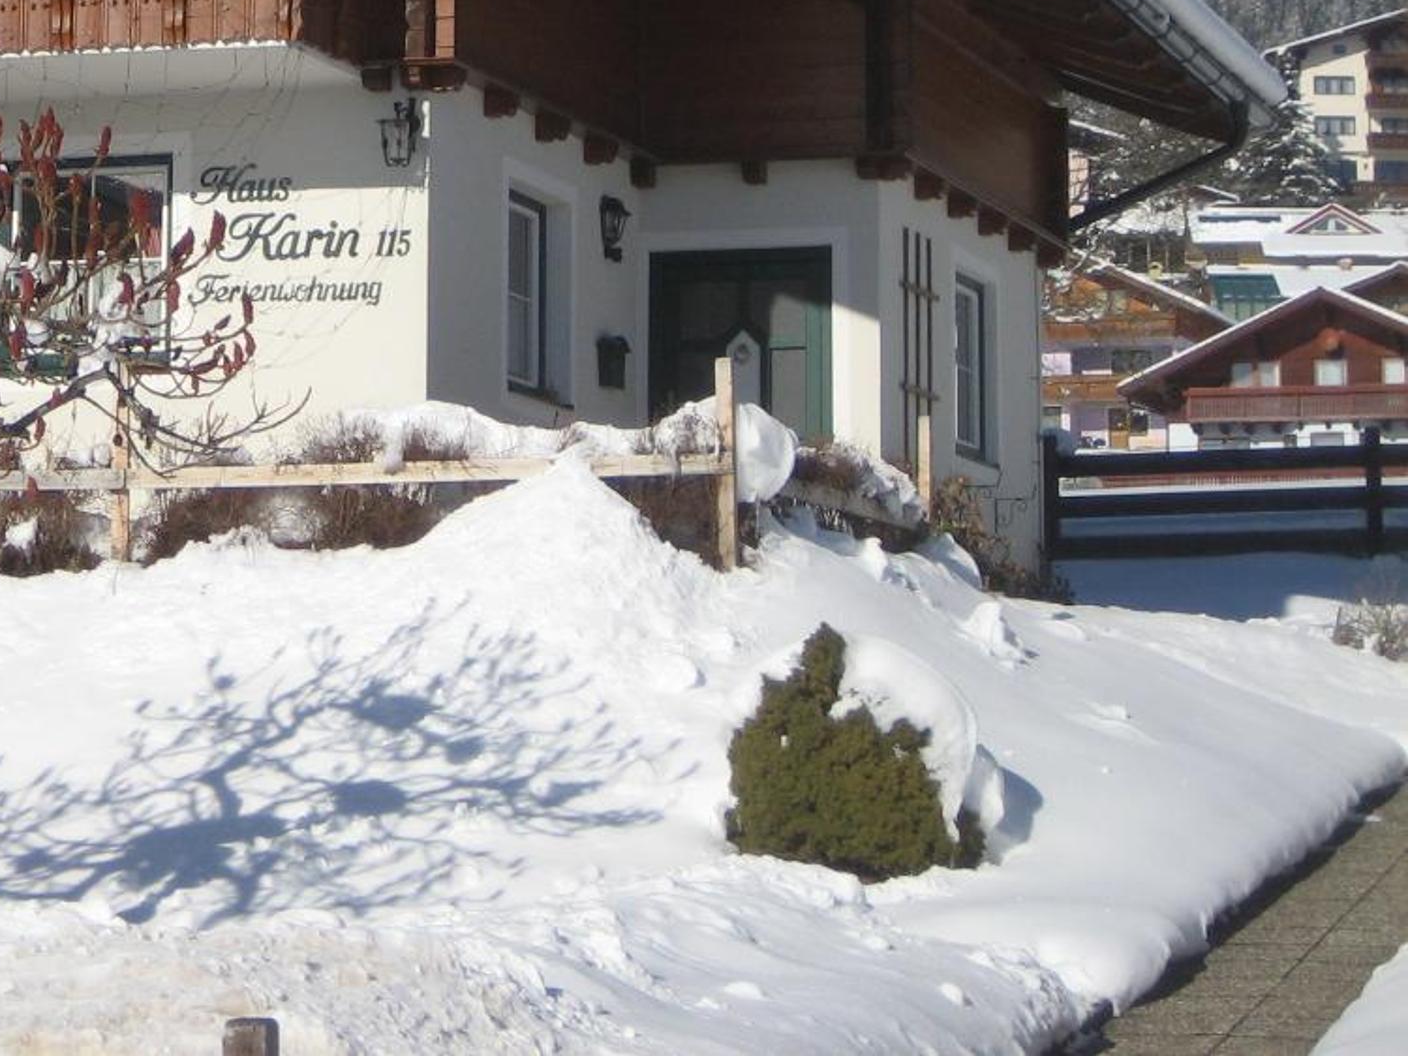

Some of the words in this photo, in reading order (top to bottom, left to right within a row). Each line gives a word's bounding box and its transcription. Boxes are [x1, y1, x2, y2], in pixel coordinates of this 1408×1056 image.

[190, 163, 292, 205] Haus
[216, 212, 359, 262] Karin
[375, 228, 412, 257] 115
[187, 274, 382, 306] Ferienwohnung
